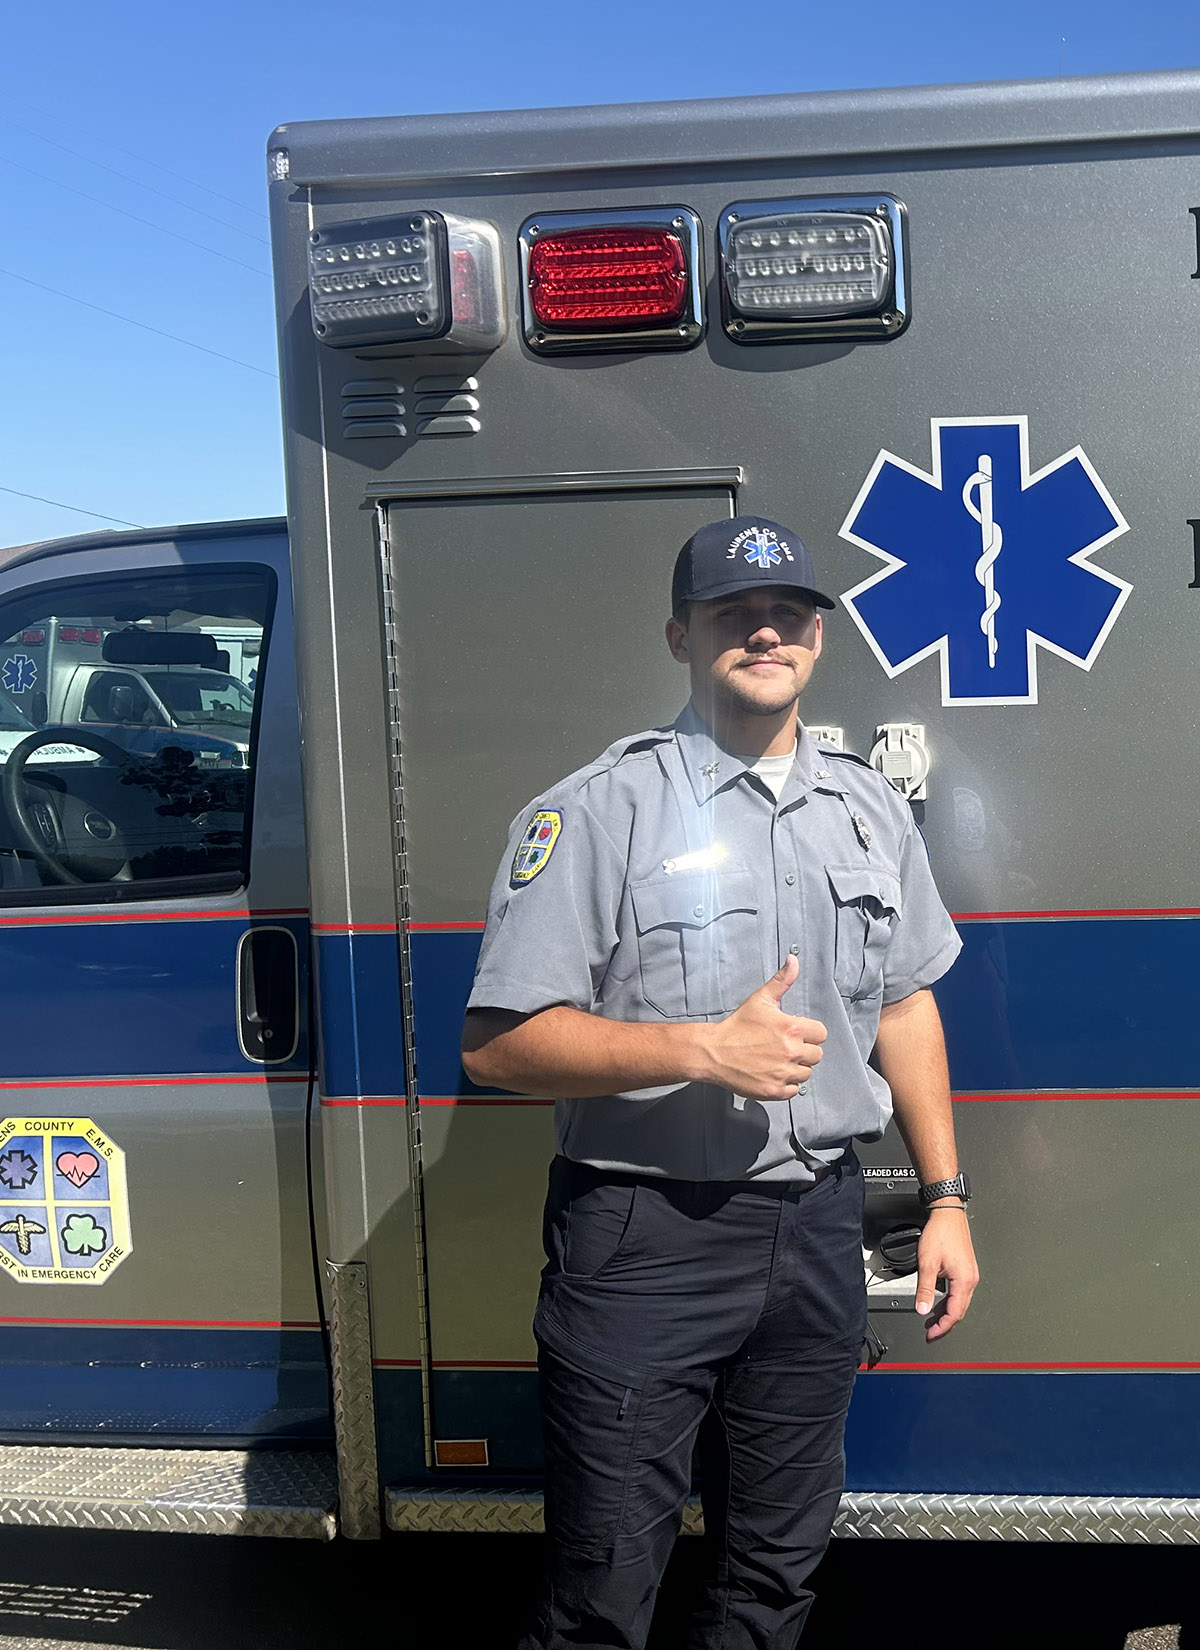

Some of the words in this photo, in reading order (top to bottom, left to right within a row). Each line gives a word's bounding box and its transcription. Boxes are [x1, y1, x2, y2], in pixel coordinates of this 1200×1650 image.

[725, 526, 760, 559] LAURENS
[779, 542, 794, 561] EMS
[24, 1121, 75, 1131] COUNTY
[85, 1128, 113, 1160] E.M.S.
[862, 1169, 891, 1177] LEADED
[893, 1169, 908, 1177] GAS
[18, 1269, 29, 1279] IN
[32, 1269, 97, 1280] EMERGENCY
[99, 1245, 124, 1272] CARE
